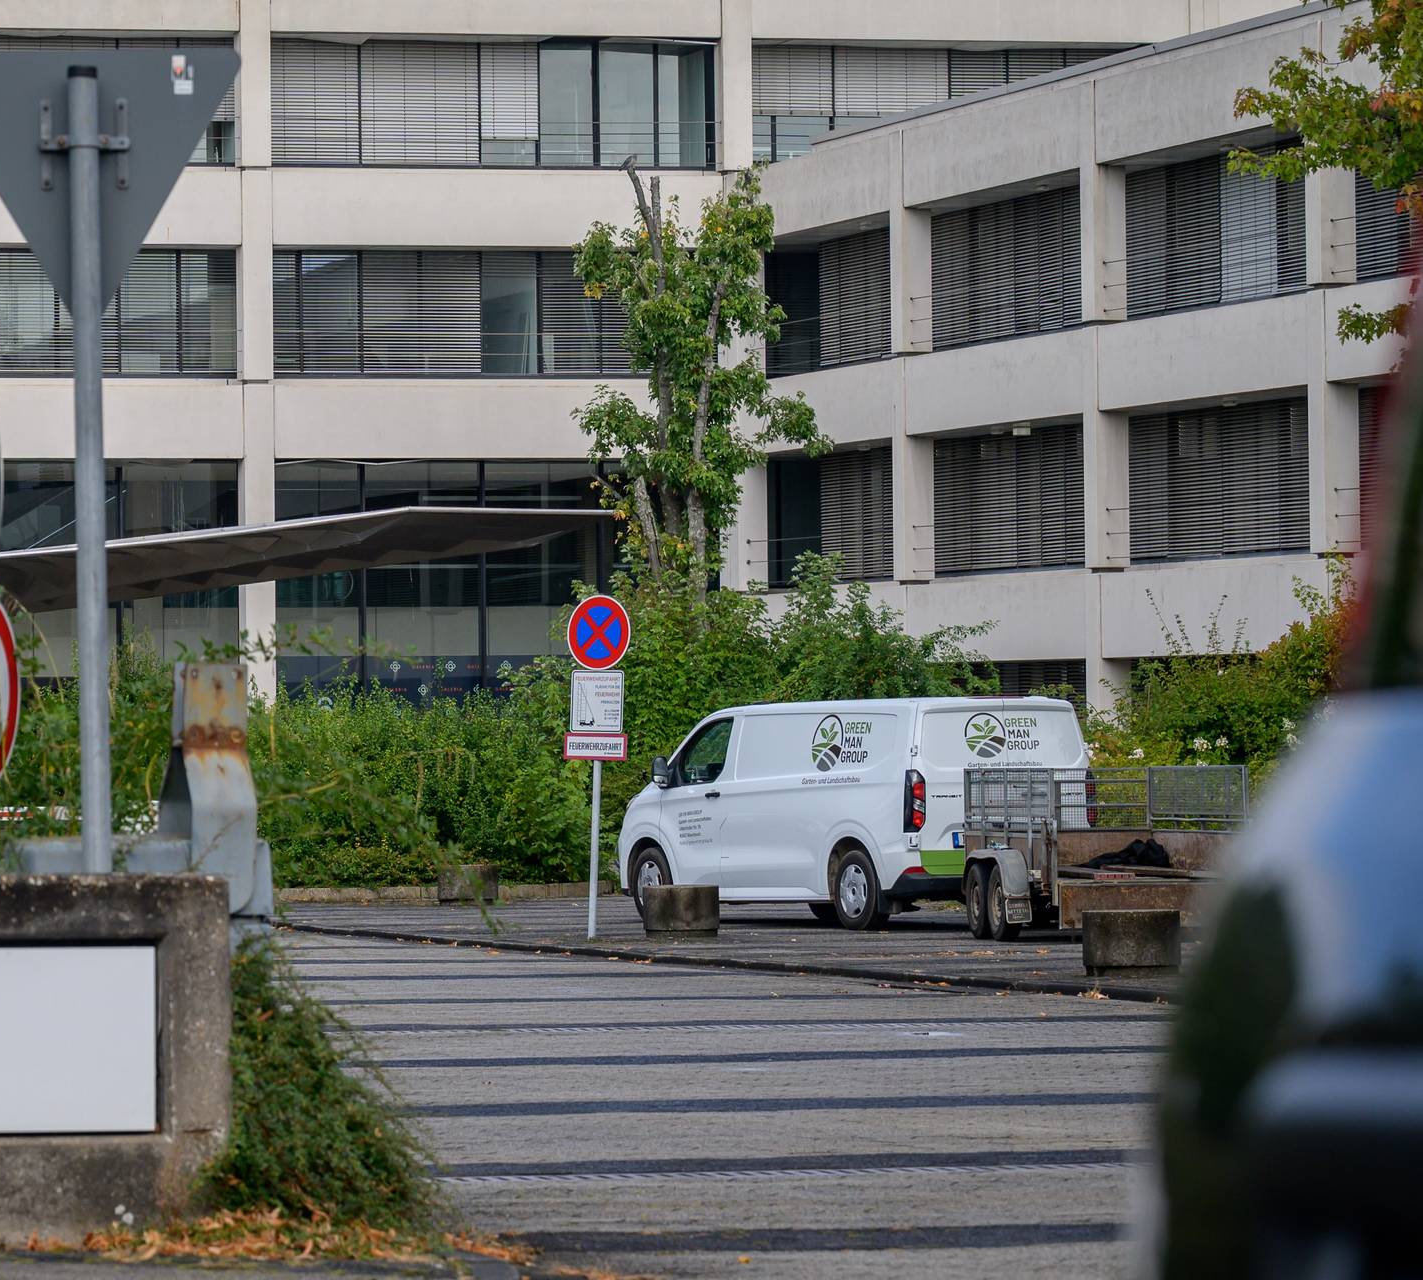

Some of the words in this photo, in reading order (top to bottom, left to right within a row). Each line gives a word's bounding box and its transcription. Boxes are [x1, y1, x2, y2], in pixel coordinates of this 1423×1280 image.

[845, 722, 872, 734] GREEN
[1004, 717, 1037, 728] GREEN
[1007, 729, 1030, 739] MAN
[569, 742, 622, 751] FEUERWEHRZUFAHRT
[844, 736, 863, 748] MAN
[1007, 740, 1040, 750] GROUP
[841, 750, 868, 763] GROUP
